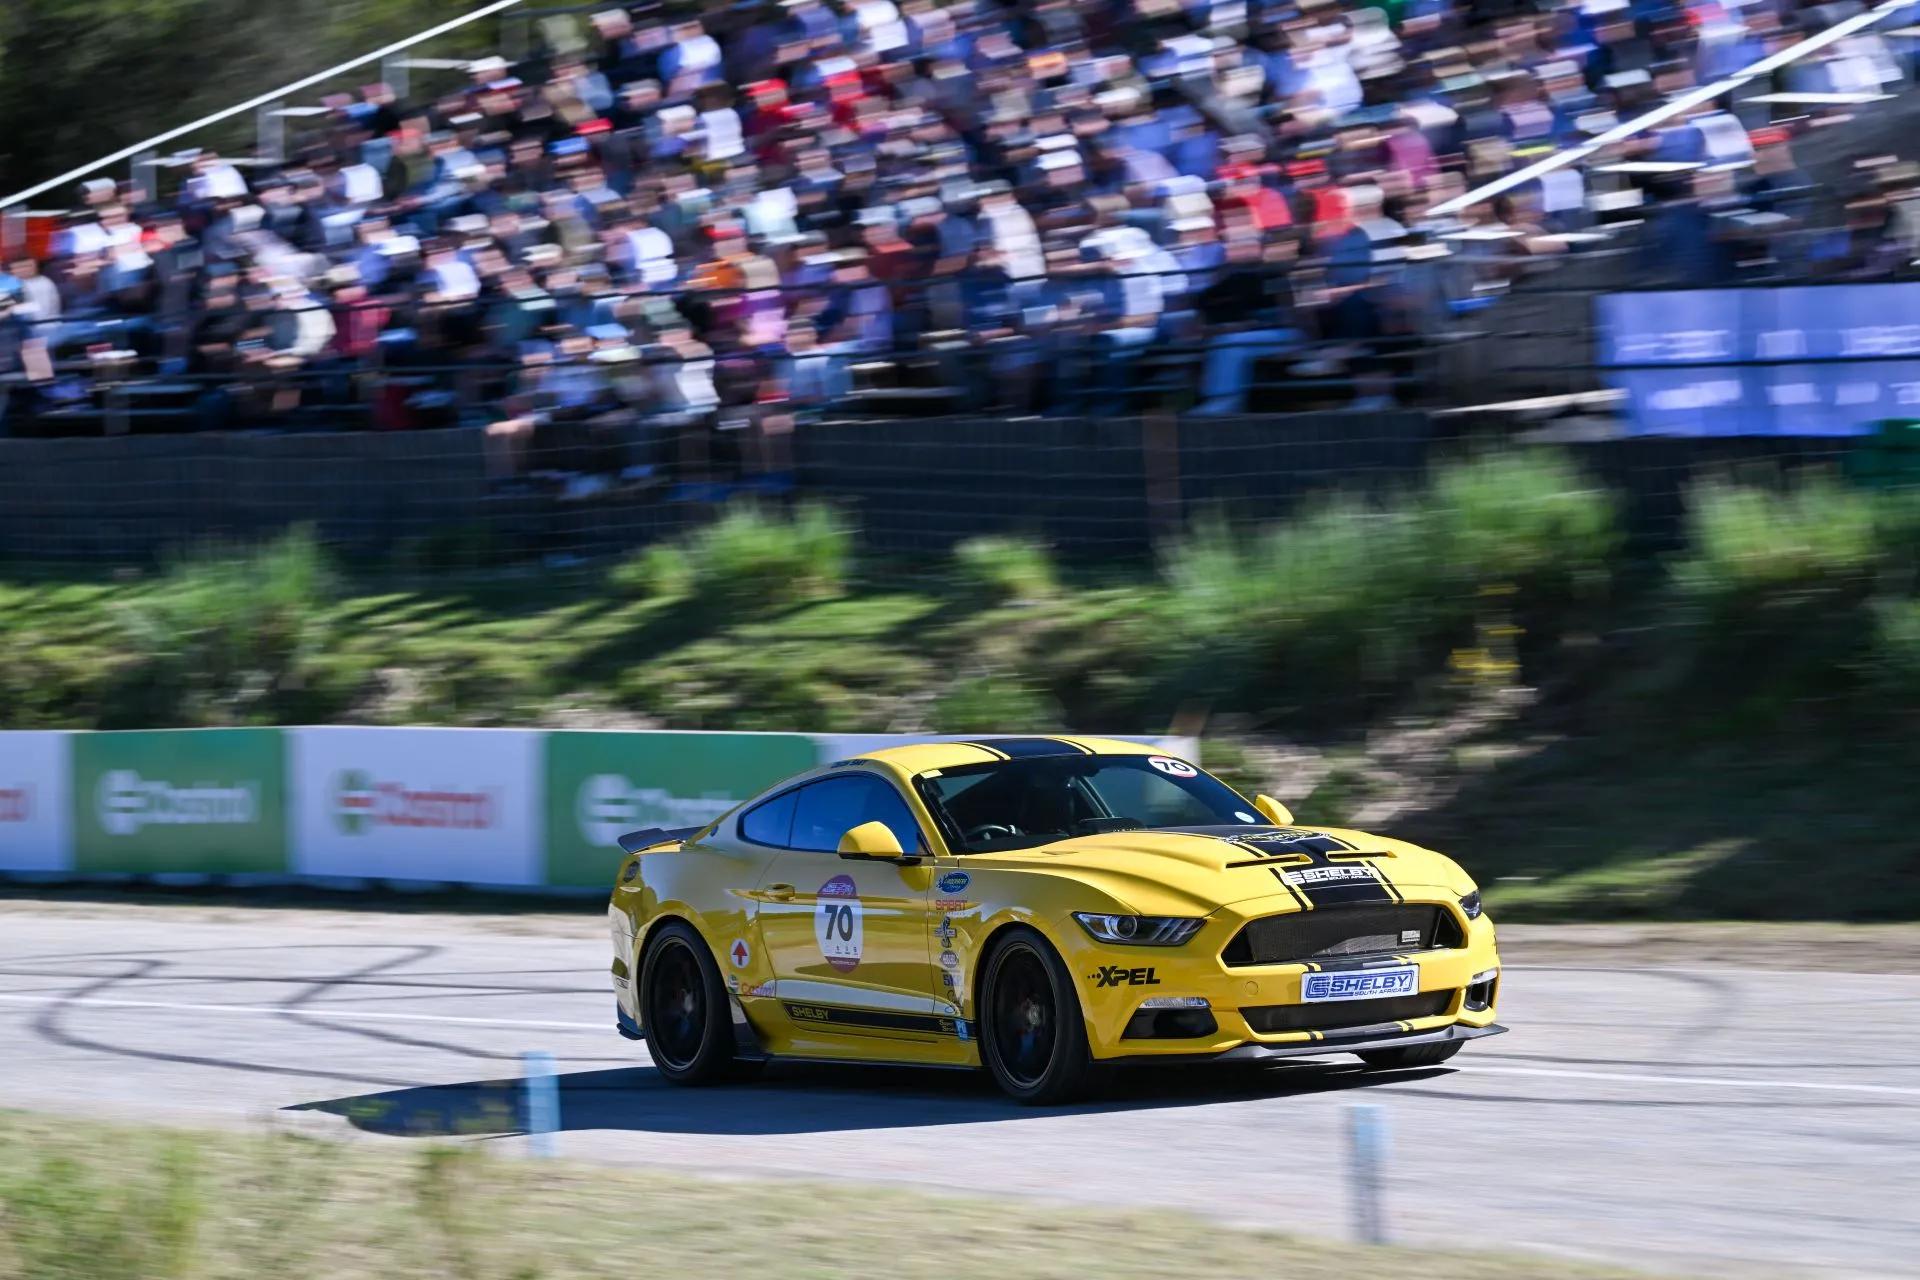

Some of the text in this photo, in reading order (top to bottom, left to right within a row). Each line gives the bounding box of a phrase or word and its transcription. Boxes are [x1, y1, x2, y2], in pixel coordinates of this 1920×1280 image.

[1154, 761, 1190, 772] 70
[1306, 868, 1374, 880] SHELBY
[825, 904, 853, 941] 70
[1096, 966, 1160, 987] XPEL
[1331, 976, 1409, 992] SHELBY
[792, 1006, 829, 1020] SHELBY
